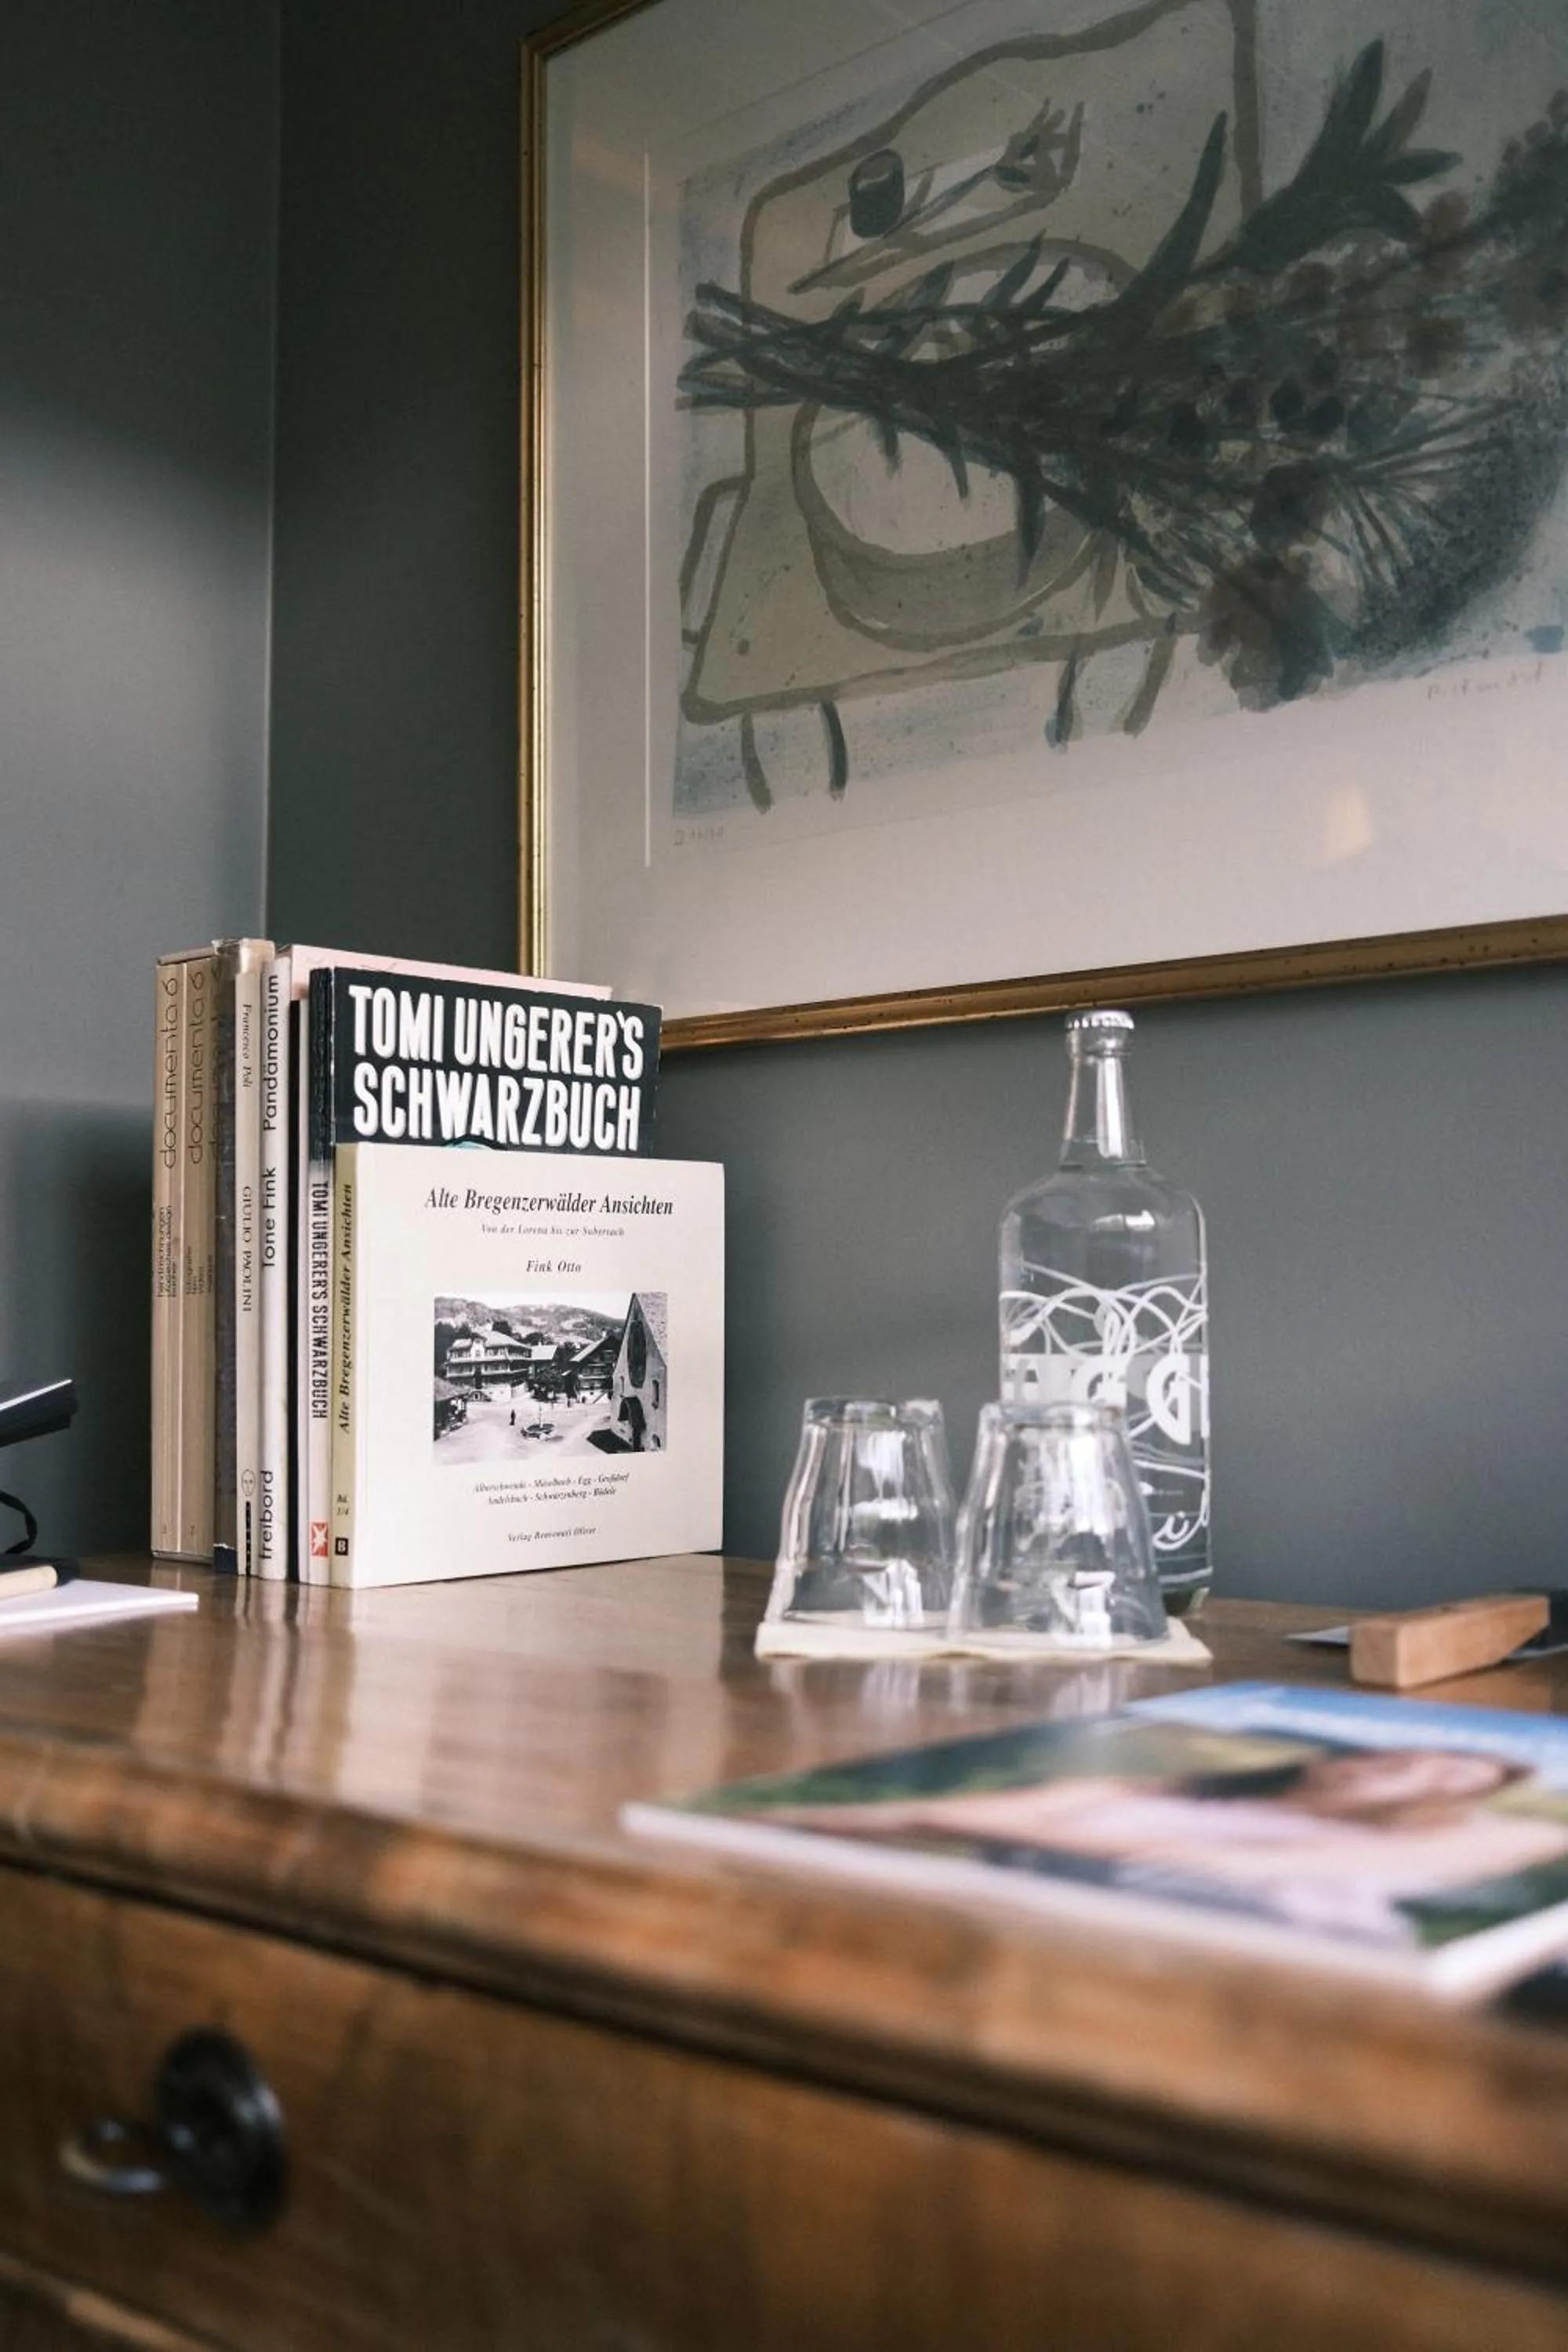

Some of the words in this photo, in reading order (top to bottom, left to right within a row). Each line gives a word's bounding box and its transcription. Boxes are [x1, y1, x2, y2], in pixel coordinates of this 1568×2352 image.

[162, 978, 177, 996] 6
[188, 971, 204, 989] 6
[242, 1004, 252, 1059] Francesco
[348, 985, 445, 1063] TOMI
[188, 998, 205, 1164] documenta
[242, 1066, 252, 1088] Poli
[263, 975, 278, 1131] Pandämonium
[159, 1005, 177, 1169] documenta
[353, 1062, 641, 1152] SCHWARZBUCH
[242, 1186, 252, 1243] GIULIO
[263, 1167, 277, 1209] Fink
[311, 1181, 328, 1217] TOMI
[424, 1188, 459, 1209] Alte
[464, 1189, 597, 1214] Bregenzerwälder
[599, 1194, 673, 1215] Ansichten
[263, 1218, 276, 1269] Tone
[339, 1184, 352, 1261] Ansichten
[481, 1224, 497, 1233] Von
[499, 1225, 515, 1233] der
[242, 1251, 252, 1312] PAOLINI
[526, 1259, 553, 1272] Fink
[557, 1259, 582, 1272] Otto
[339, 1265, 352, 1396] Bregenzerwälder
[311, 1305, 328, 1419] SCHWARZBUCH
[339, 1402, 350, 1434] Alte
[260, 1470, 274, 1559] freibord
